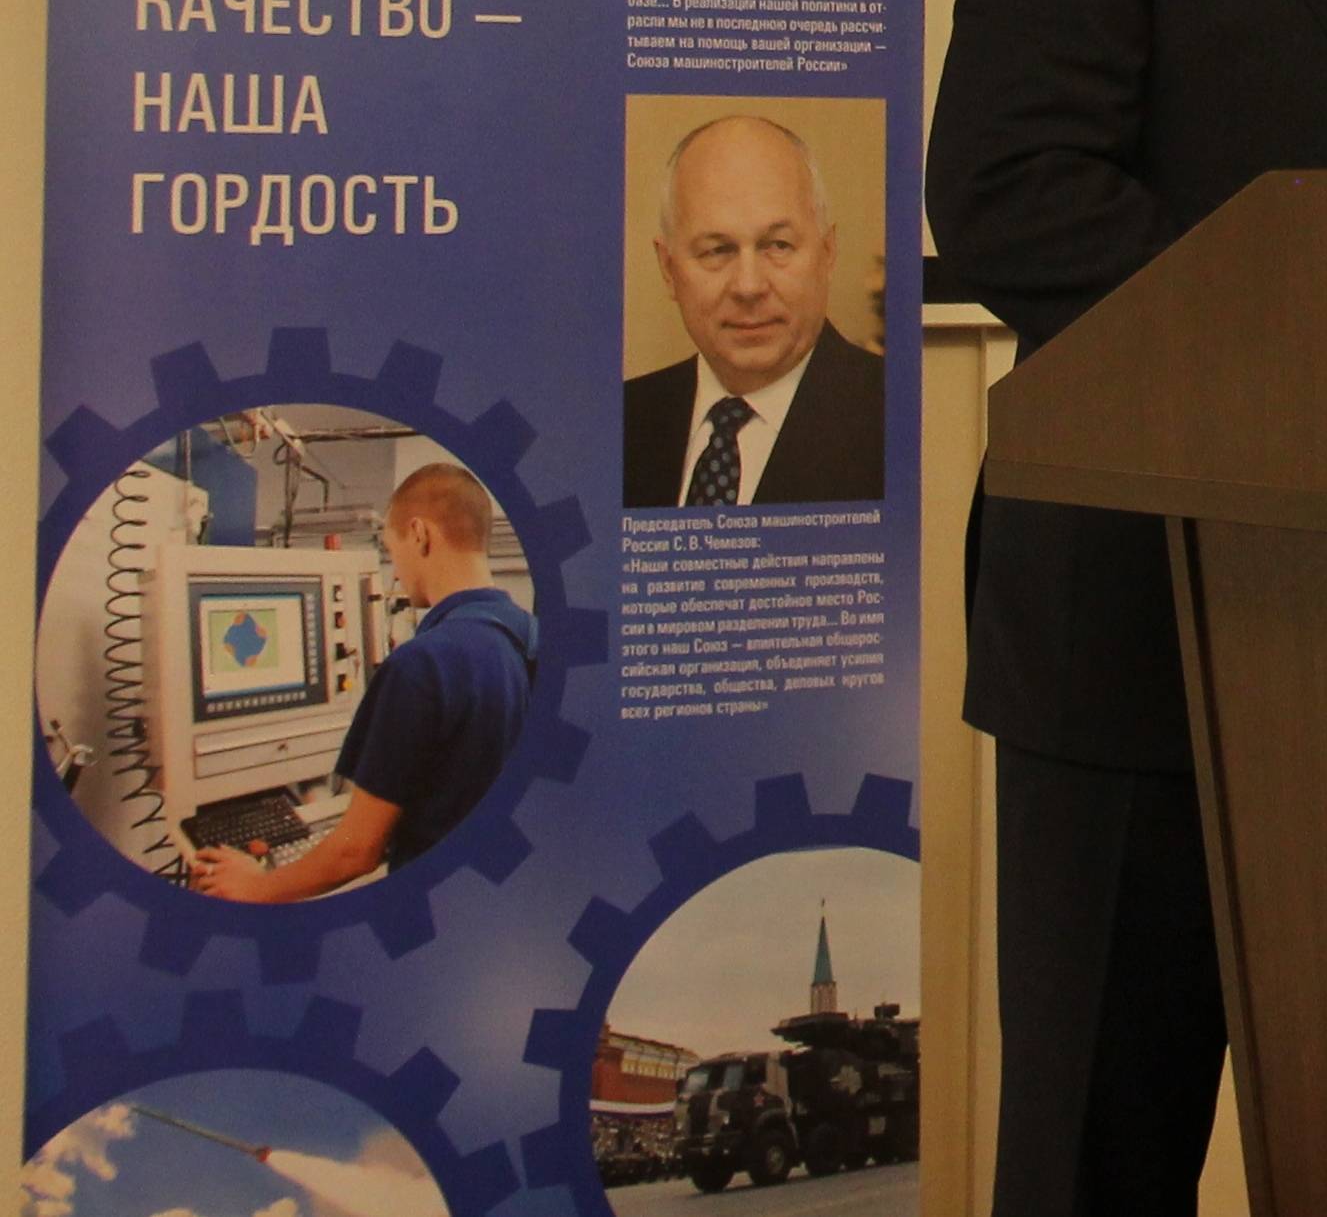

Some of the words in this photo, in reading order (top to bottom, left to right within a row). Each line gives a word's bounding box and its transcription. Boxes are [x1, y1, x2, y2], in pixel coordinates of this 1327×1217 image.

[801, 0, 857, 13] политики
[860, 3, 867, 13] в
[869, 3, 887, 14] от-
[627, 16, 665, 30] расли
[668, 18, 688, 28] мы
[690, 18, 705, 28] не
[707, 19, 715, 29] в
[716, 18, 786, 31] последнюю
[789, 20, 838, 34] очередь
[841, 22, 887, 36] рассчи-
[628, 36, 675, 48] тываем
[679, 37, 694, 48] на
[698, 38, 748, 51] помощь
[751, 37, 790, 50] вашей
[794, 40, 871, 54] организации
[627, 53, 669, 68] Союза
[673, 57, 793, 72] машиностроителей
[797, 57, 848, 72] России»
[133, 72, 328, 135] НАША
[131, 172, 459, 246] ГОРДОСТЬ
[623, 516, 713, 535] Председатель
[717, 514, 758, 529] Союза
[761, 509, 880, 528] машиностроителей
[623, 537, 670, 553] России
[673, 536, 687, 551] С.
[689, 535, 702, 551] В.
[704, 535, 761, 550] Чемезов:
[623, 558, 668, 573] «Наши
[673, 558, 749, 572] совместные
[752, 553, 809, 570] действия
[812, 553, 885, 568] направлены
